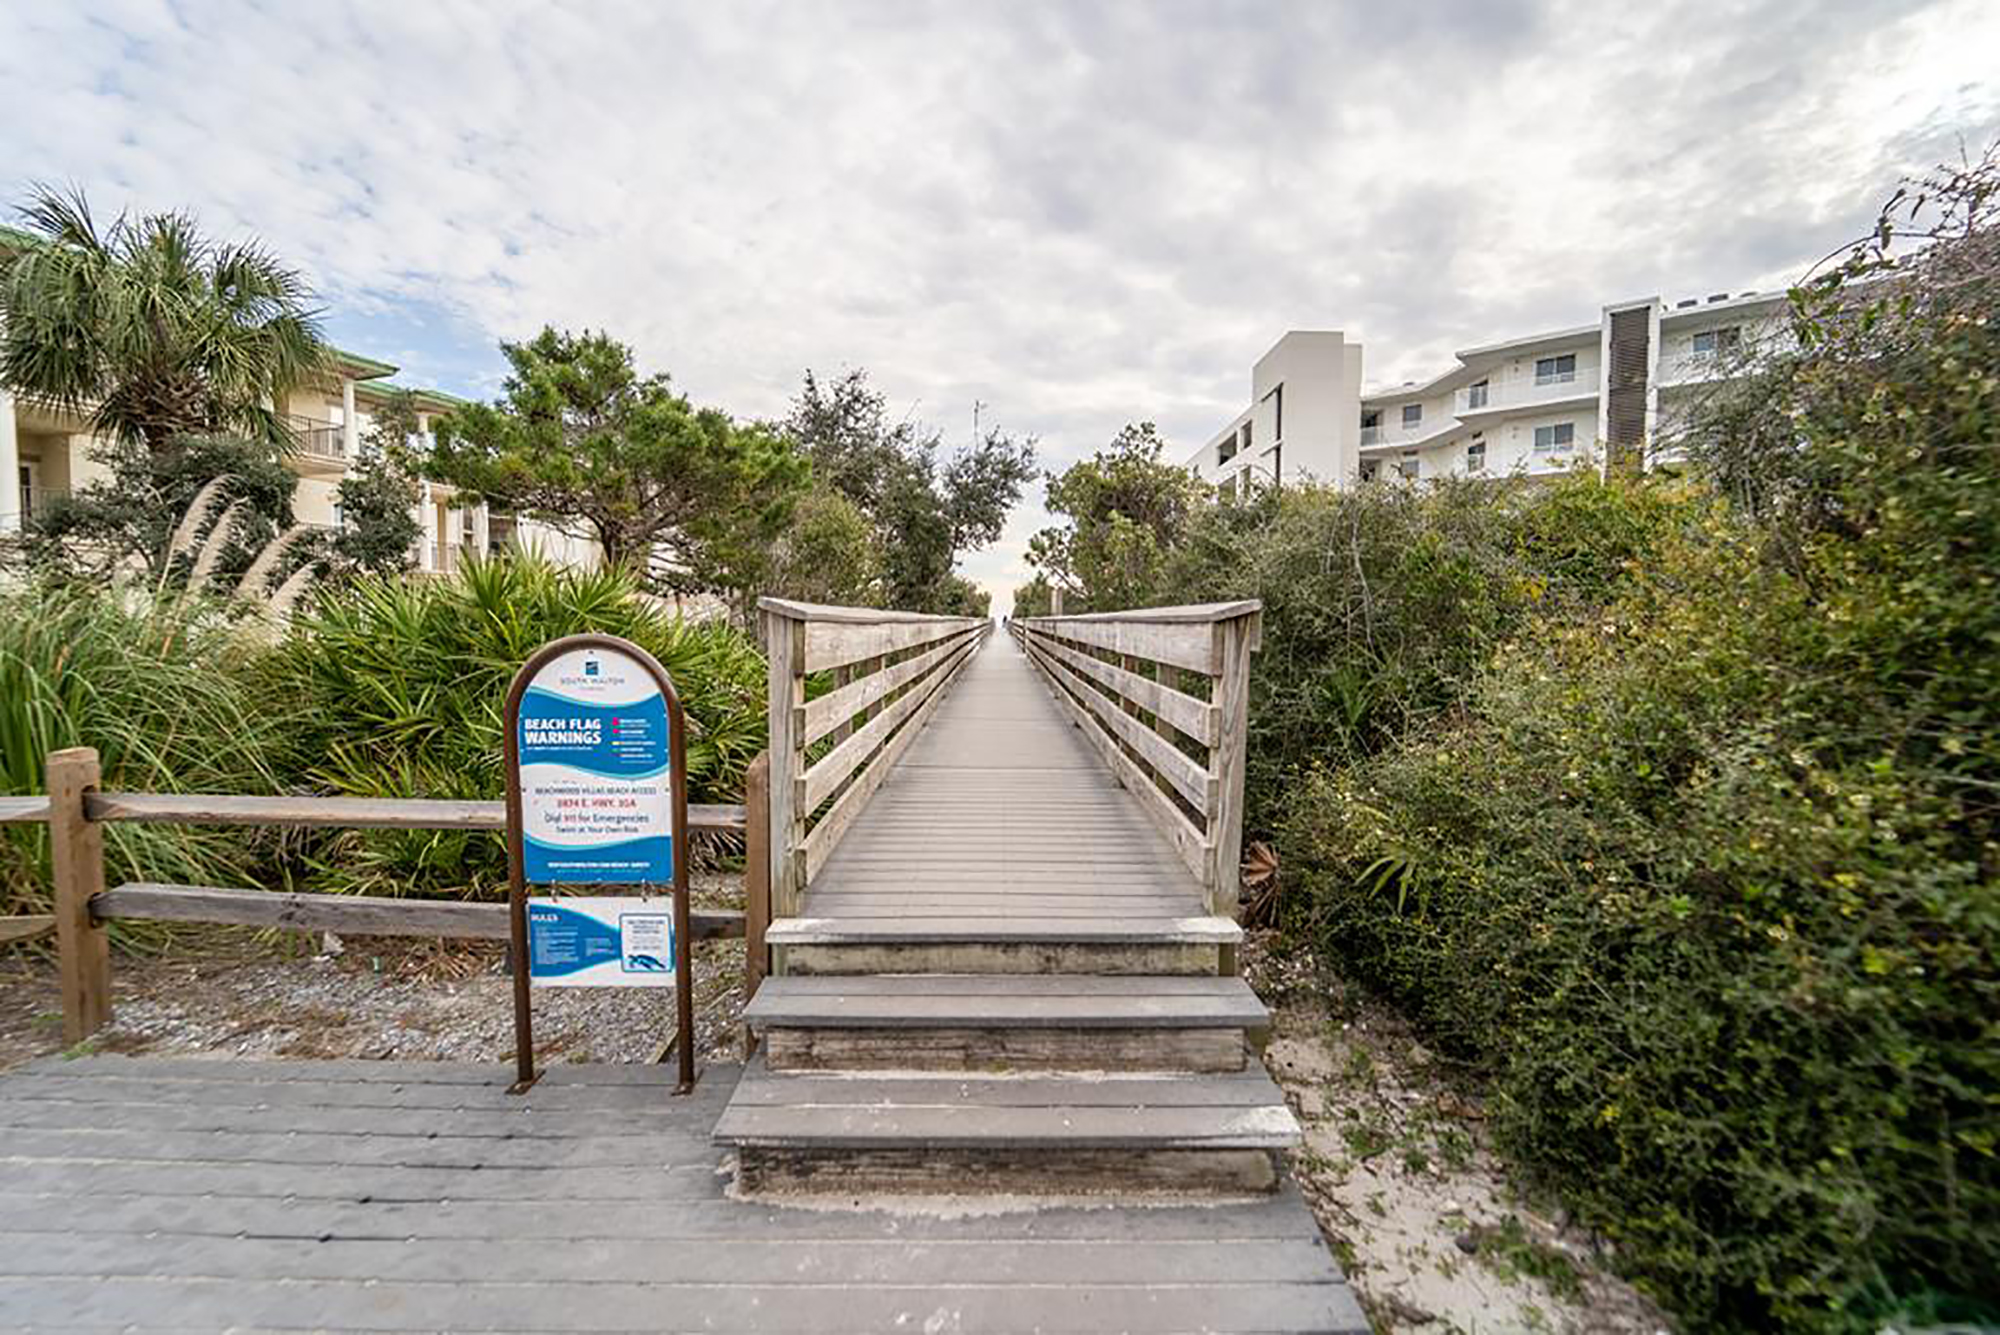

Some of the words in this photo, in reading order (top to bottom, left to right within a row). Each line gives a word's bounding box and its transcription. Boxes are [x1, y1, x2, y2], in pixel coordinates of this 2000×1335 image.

[524, 718, 566, 730] BEACH
[569, 718, 602, 730] FLAG
[524, 731, 602, 745] WARNINGS
[607, 786, 630, 795] BEACH
[578, 812, 591, 822] for
[593, 813, 650, 825] Emergencies
